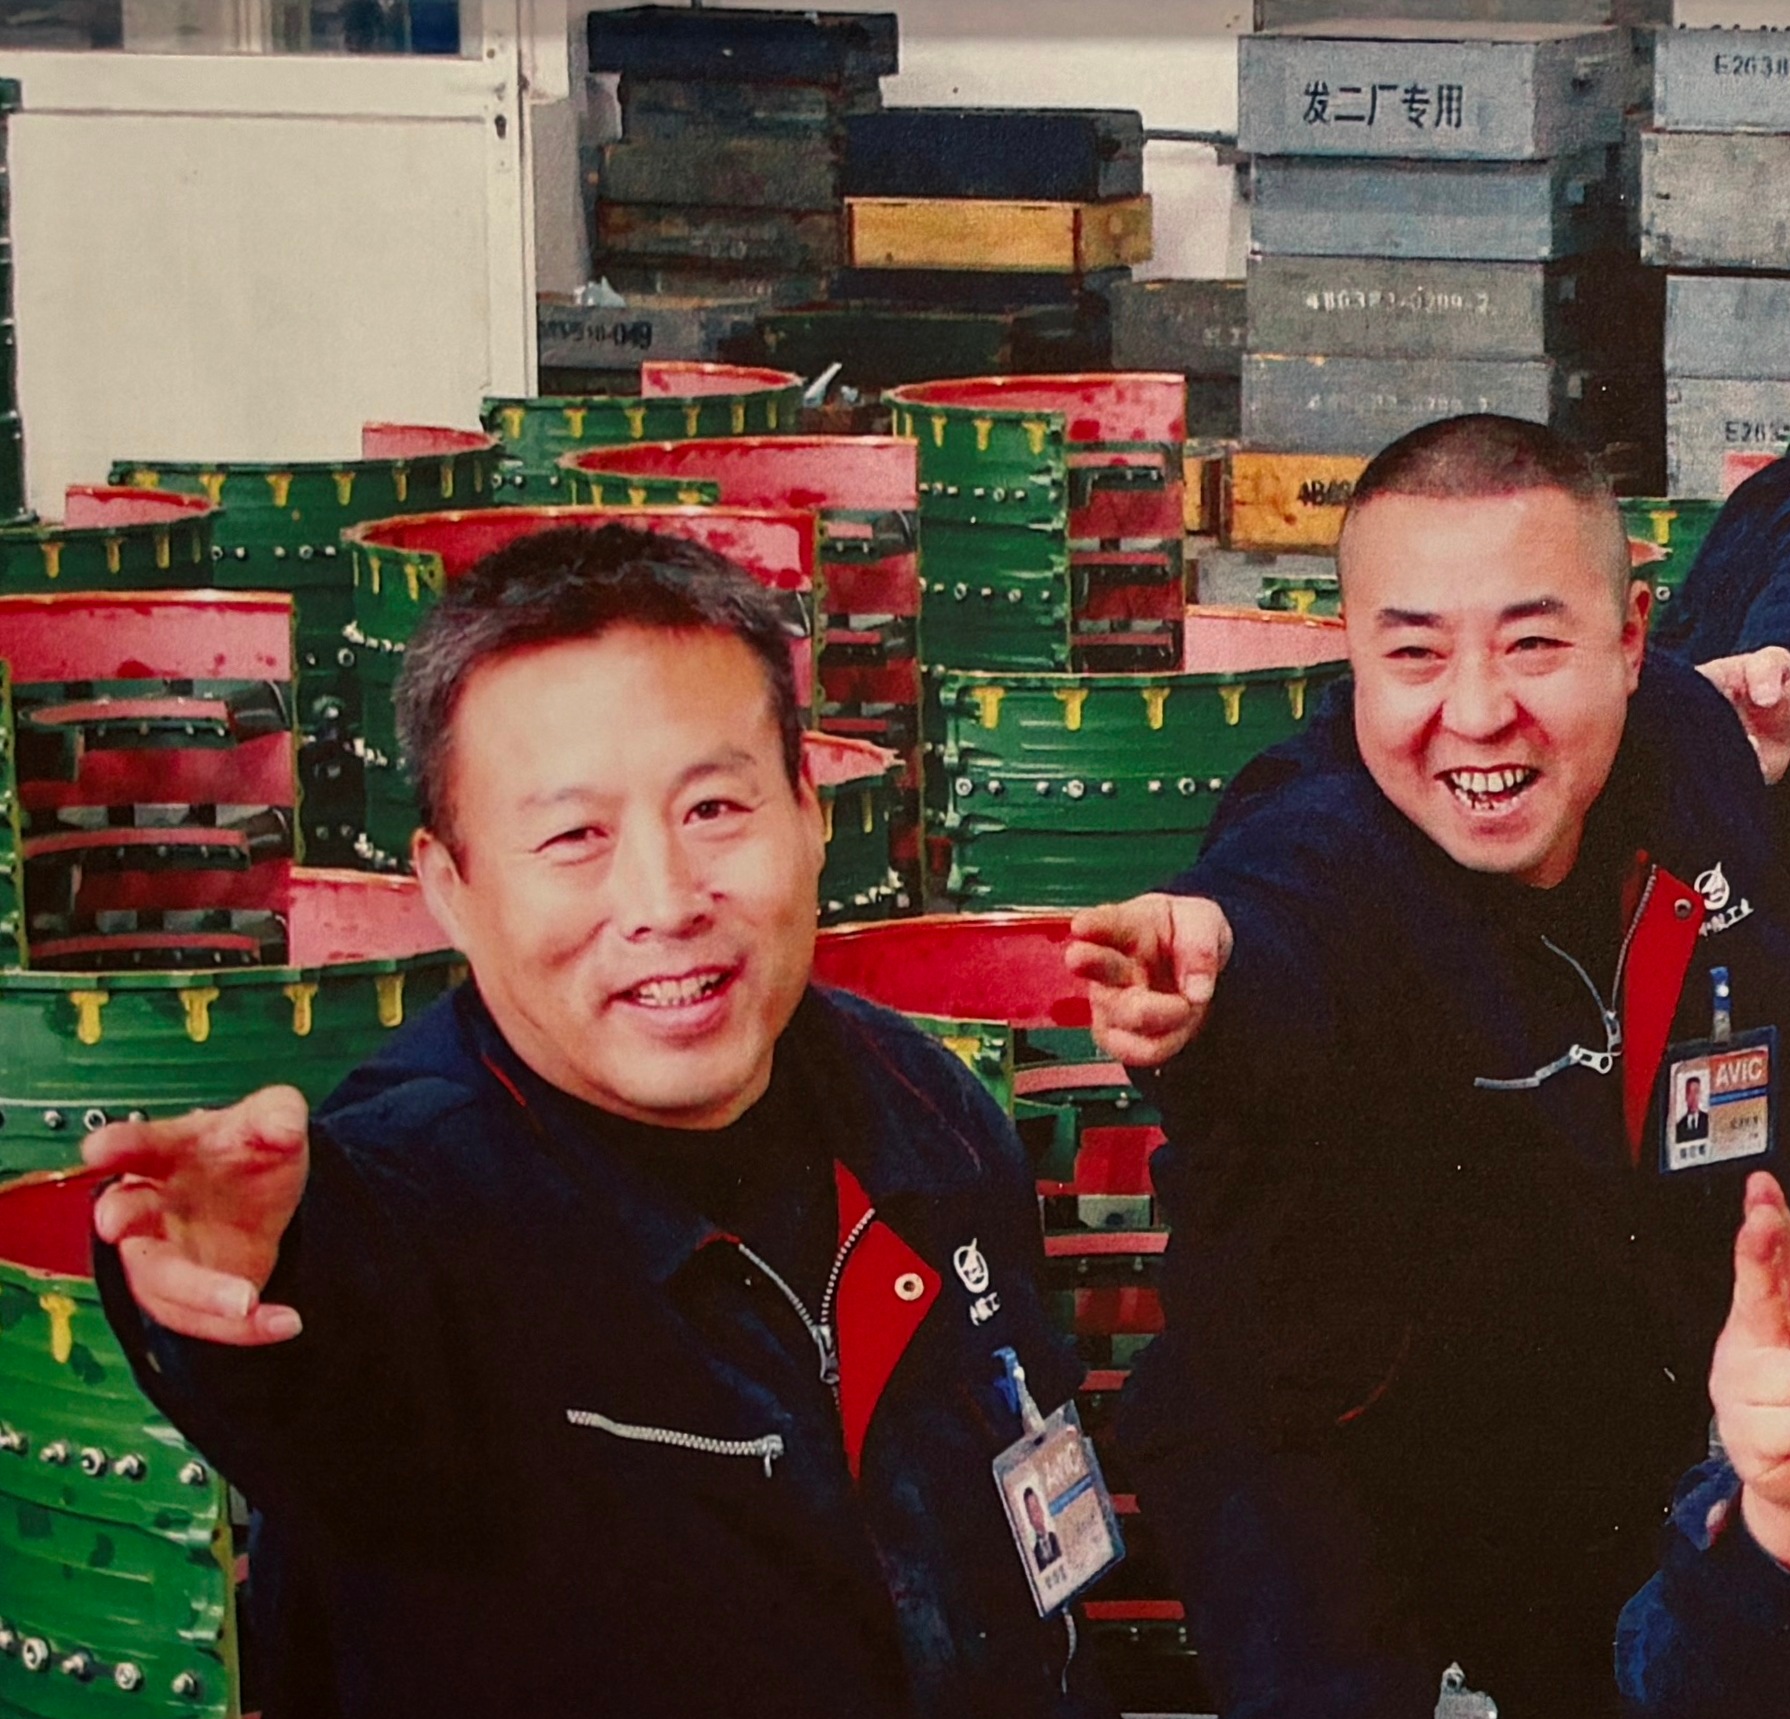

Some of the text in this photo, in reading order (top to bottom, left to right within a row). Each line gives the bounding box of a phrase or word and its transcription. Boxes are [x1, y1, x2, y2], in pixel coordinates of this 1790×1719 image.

[1303, 80, 1464, 128] 发二厂专用
[1715, 1056, 1763, 1087] AVIC
